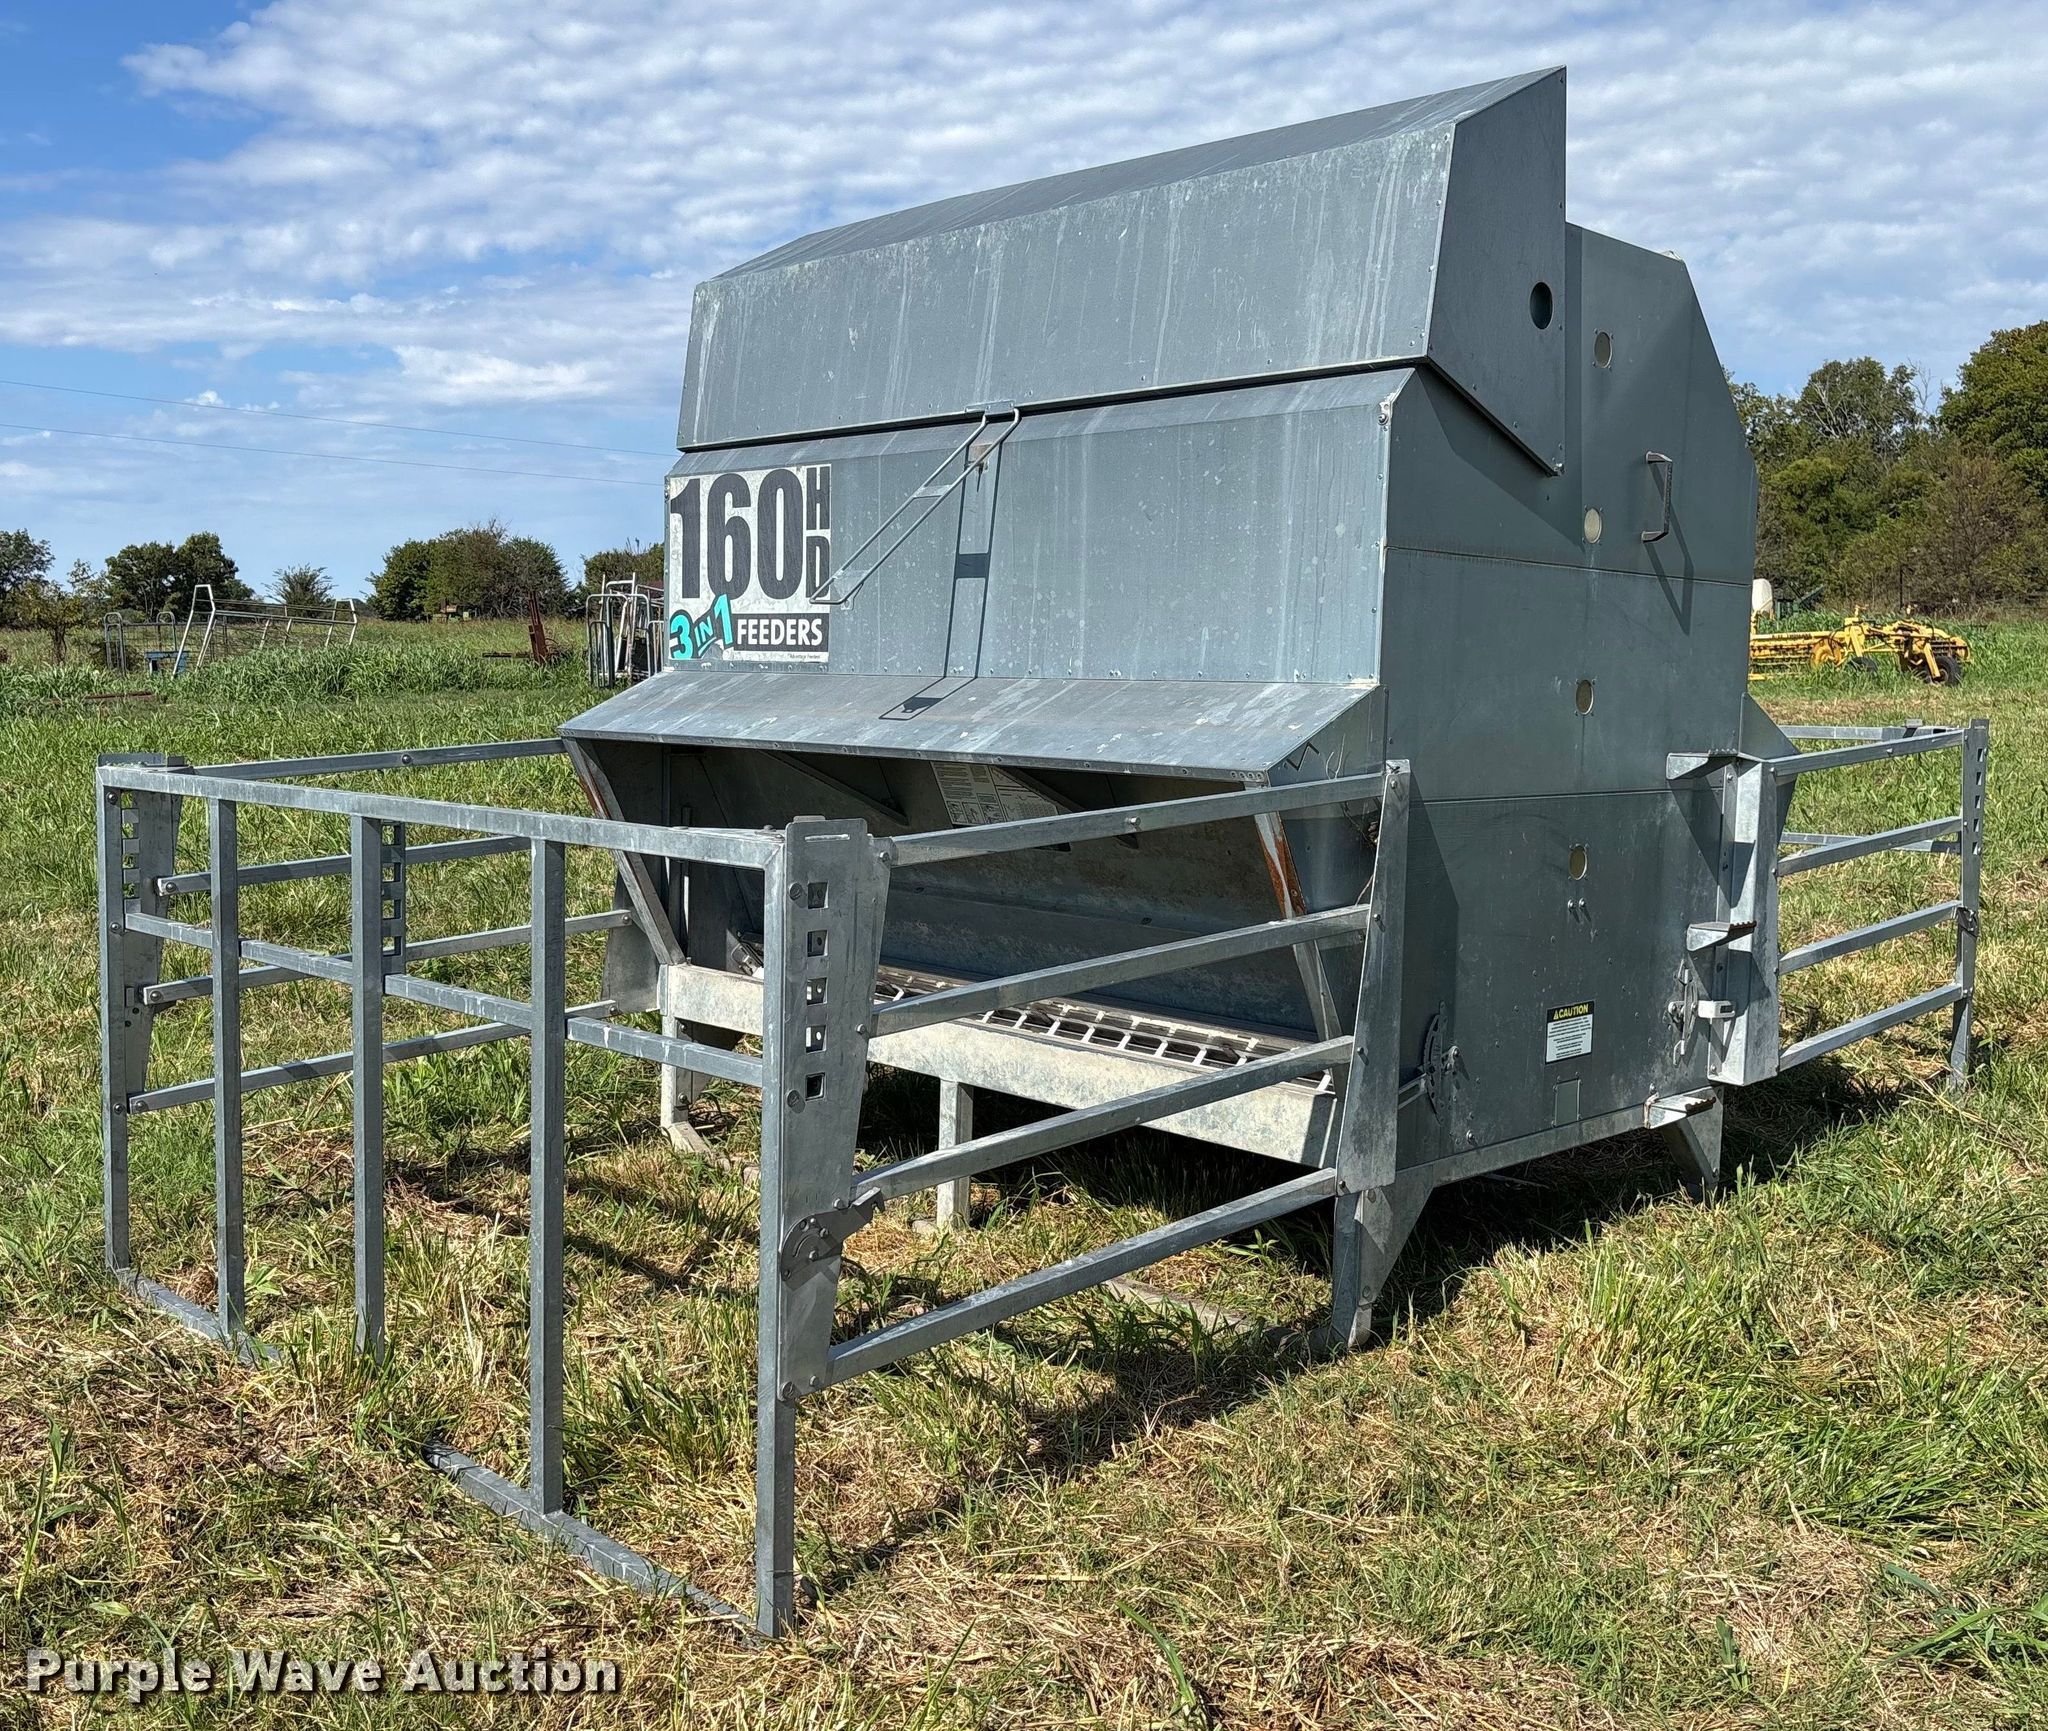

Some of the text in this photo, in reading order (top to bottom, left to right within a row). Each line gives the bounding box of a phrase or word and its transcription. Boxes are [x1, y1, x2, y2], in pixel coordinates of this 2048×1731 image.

[670, 468, 804, 600] 160
[671, 593, 823, 659] 3 IN 1 FEEDERS
[1559, 1004, 1588, 1018] CAUTION
